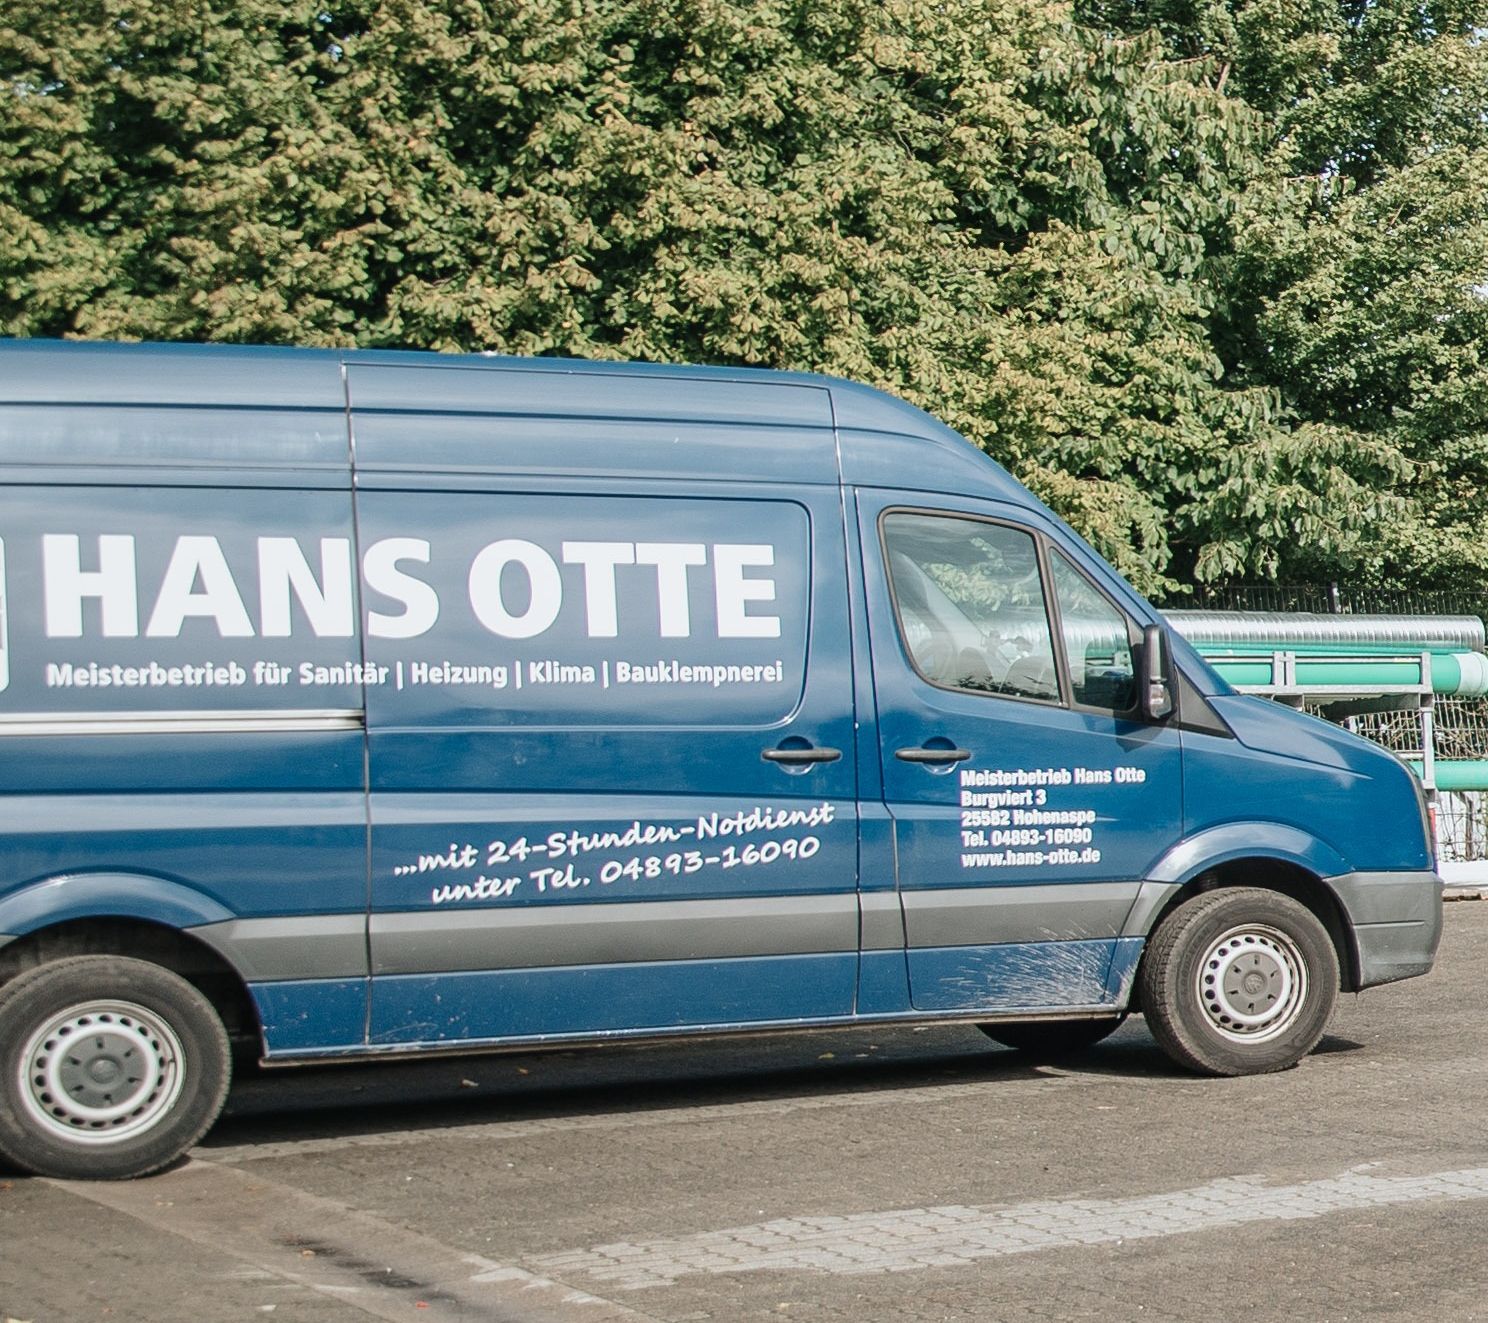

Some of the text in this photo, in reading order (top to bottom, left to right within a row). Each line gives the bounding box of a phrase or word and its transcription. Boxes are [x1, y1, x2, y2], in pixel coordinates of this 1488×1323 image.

[43, 534, 780, 638] HANS OTTE
[47, 662, 245, 686] Meisterbetrieb
[253, 661, 291, 684] für
[299, 661, 389, 684] Sanitär
[412, 661, 507, 688] Heizung
[530, 661, 595, 683] Klima
[617, 661, 782, 687] Bauklempnerei
[961, 767, 1145, 786] Meisterbetrieb Hans Otte
[961, 789, 1046, 808] Burgviert 3
[961, 809, 1096, 827] 25582 Hohenaspe
[487, 801, 836, 866] 24-Stunden-Notdienst
[961, 828, 1092, 846] Tel. 04893-16090
[961, 848, 1101, 867] www.hans-otte.de
[433, 836, 820, 903] unter Tel. 04893-16090
